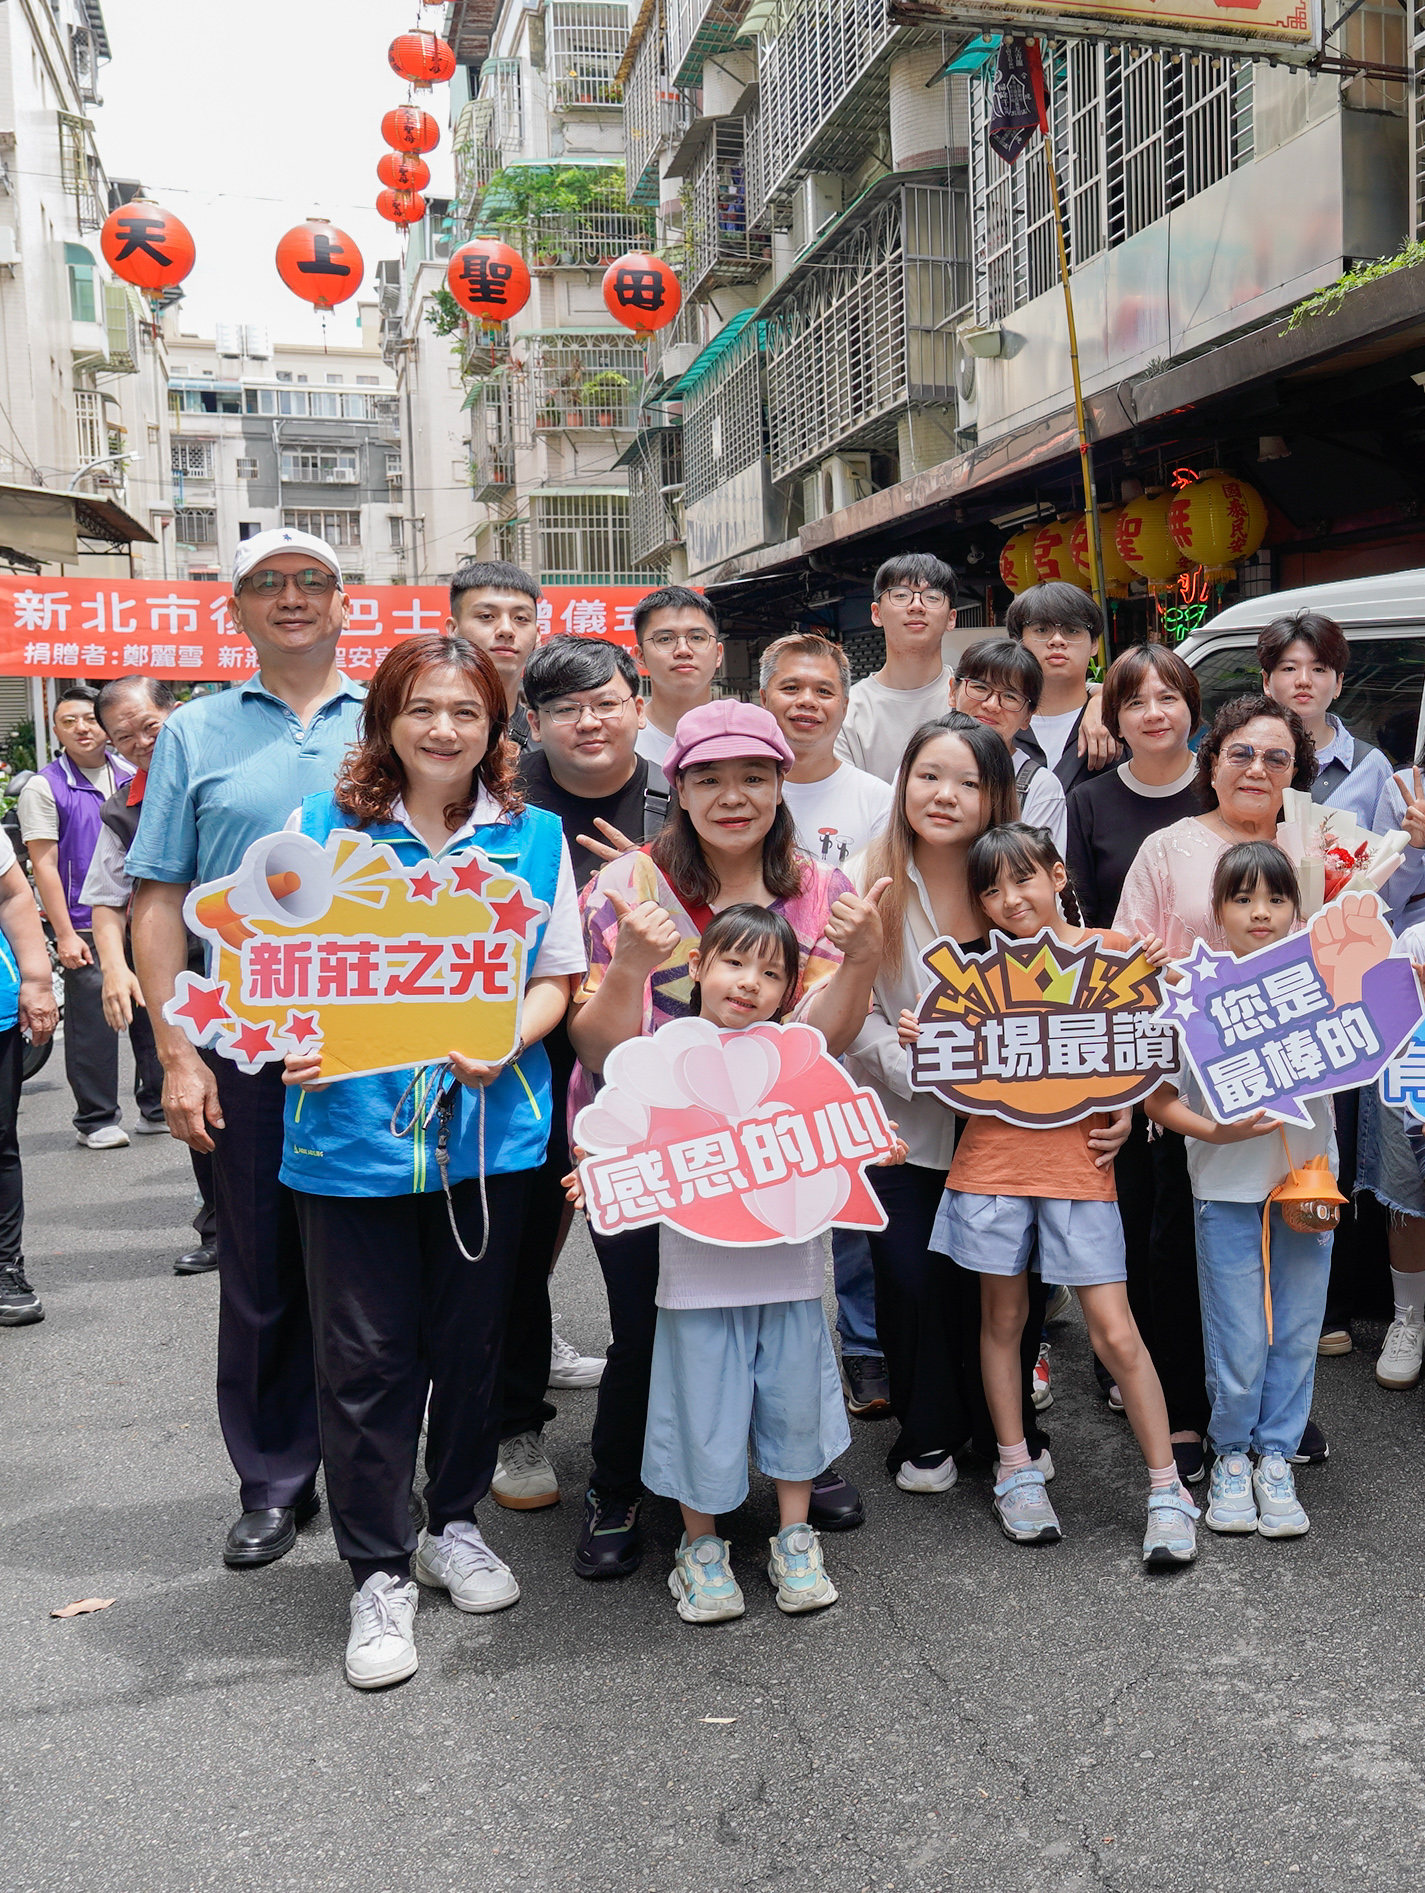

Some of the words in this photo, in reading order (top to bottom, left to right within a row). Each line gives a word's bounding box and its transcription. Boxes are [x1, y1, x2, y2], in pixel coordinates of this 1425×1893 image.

[1222, 482, 1250, 554] 國泰民安
[24, 642, 204, 668] 捐贈者:鄭麗雪
[249, 939, 509, 999] 新莊之光
[1210, 961, 1329, 1047] 您是
[916, 1012, 1176, 1082] 全場最讚
[1207, 1006, 1380, 1113] 最棒的
[592, 1097, 888, 1225] 感恩的心
